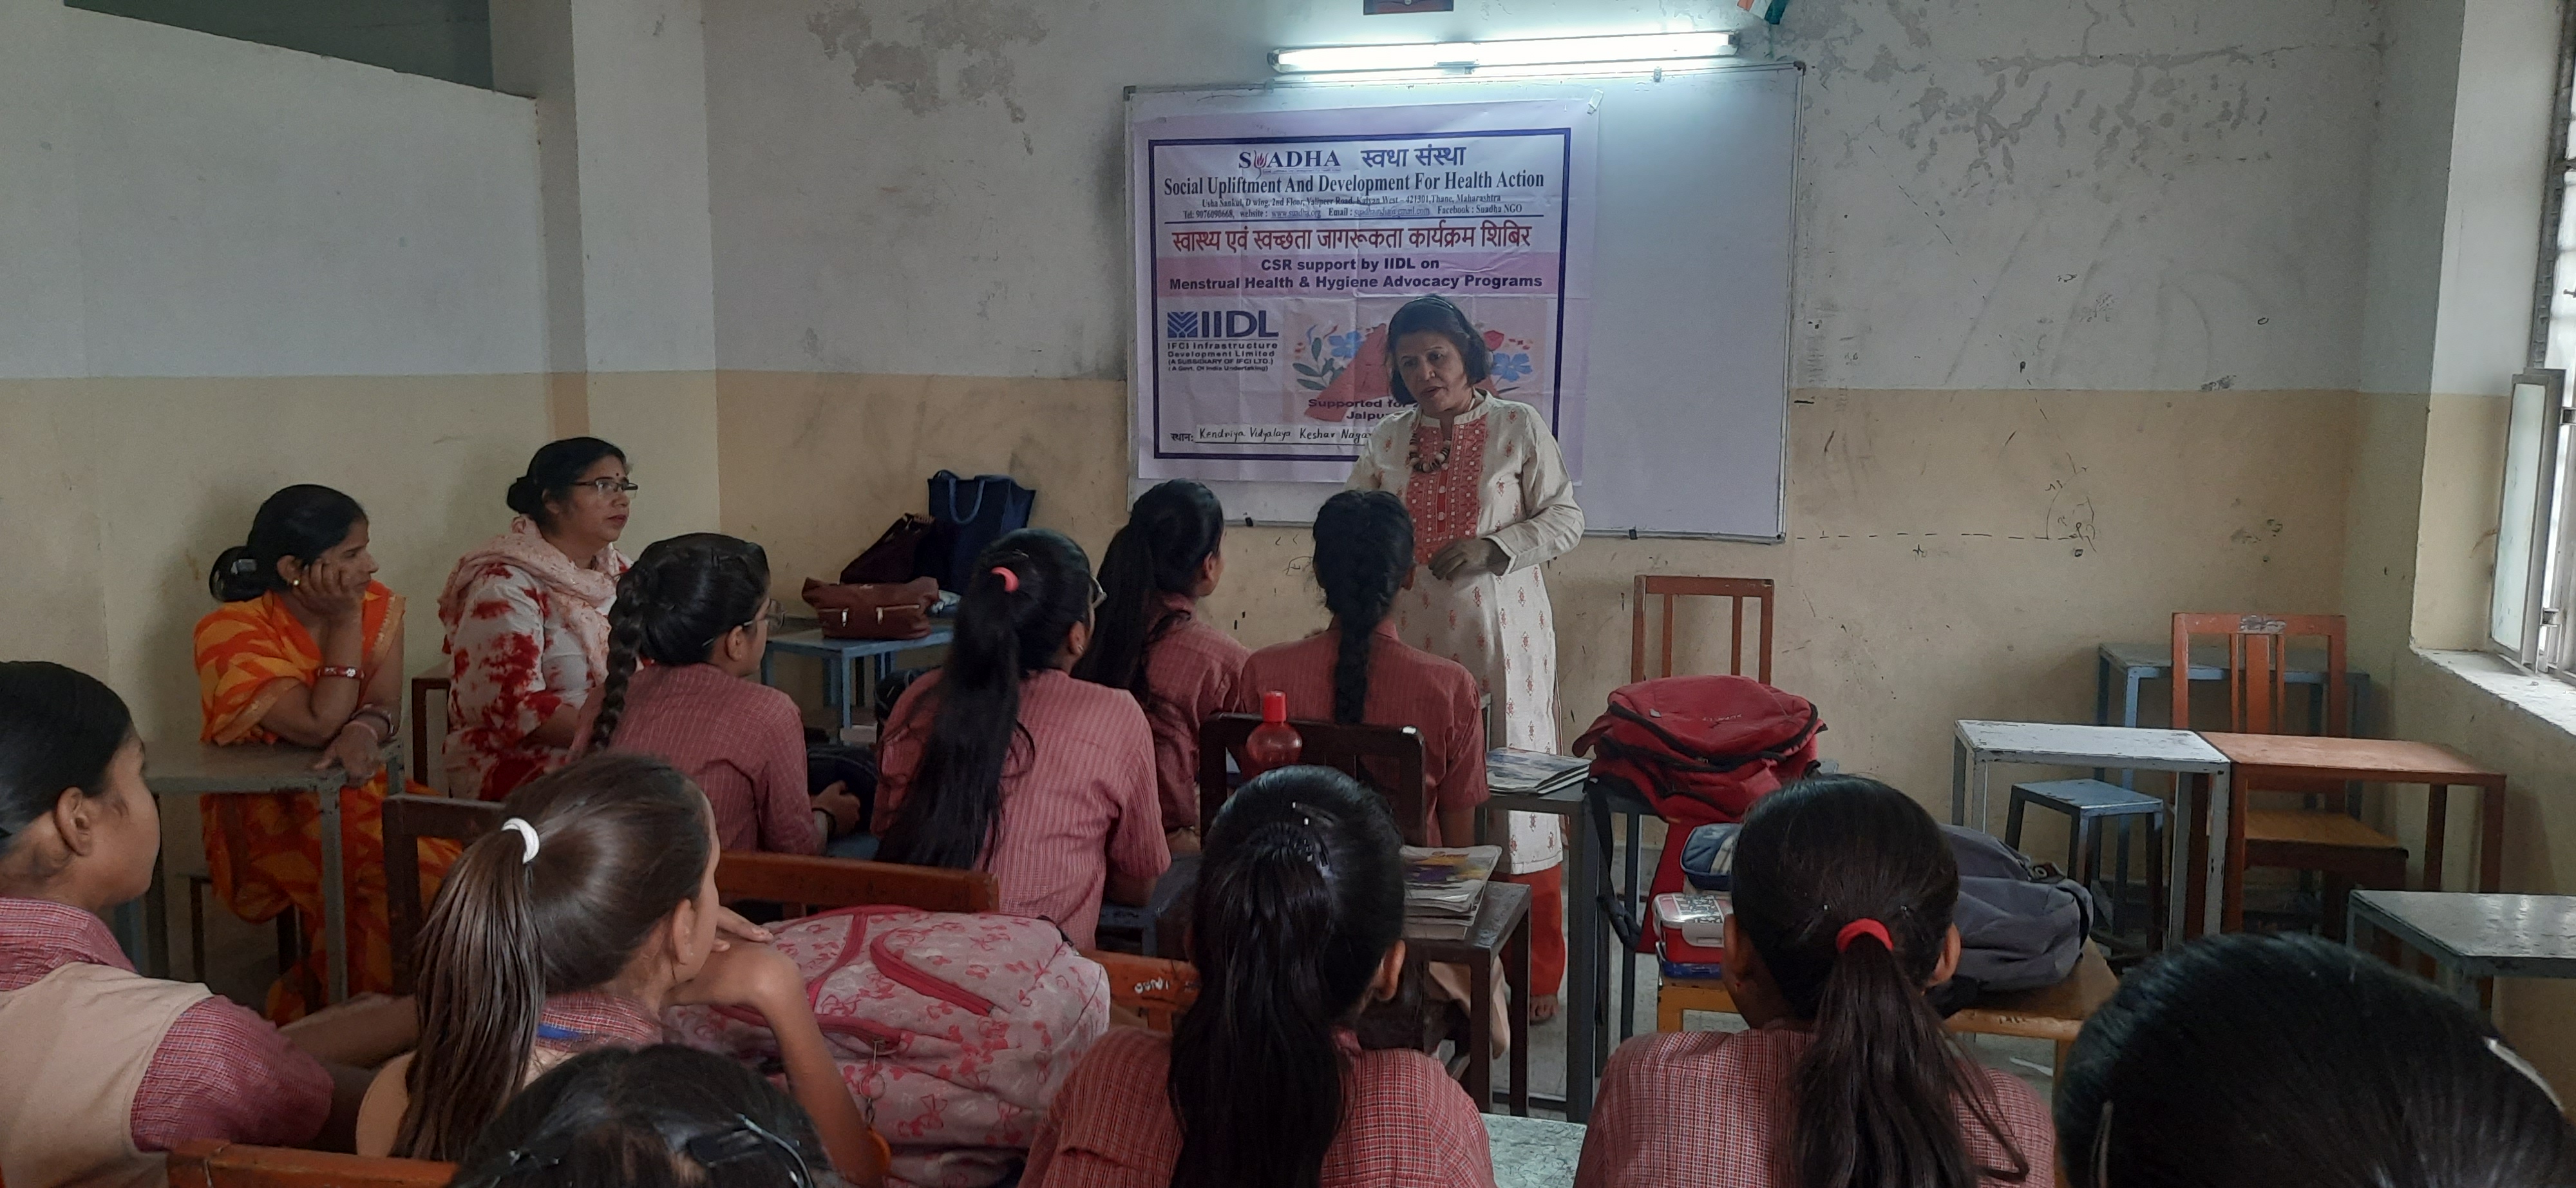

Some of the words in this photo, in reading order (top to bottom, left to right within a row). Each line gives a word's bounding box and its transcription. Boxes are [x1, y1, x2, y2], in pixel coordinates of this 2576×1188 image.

[1360, 149, 1409, 168] स्वधा
[1414, 144, 1466, 166] संस्था
[1164, 178, 1203, 195] Social
[1208, 176, 1282, 199] Upliftment
[1287, 174, 1313, 193] And
[1318, 173, 1410, 196] Development
[1416, 172, 1440, 189] For
[1444, 171, 1492, 189] Health
[1496, 169, 1544, 187] Action
[1202, 198, 1218, 207] Usha
[1245, 198, 1251, 206] D
[1272, 197, 1284, 206] 2nd
[1357, 195, 1380, 206] Kalyan
[1382, 195, 1398, 204] West
[1456, 193, 1501, 202] Maharashtra
[1240, 209, 1264, 218] website
[1329, 207, 1348, 216] Email
[1437, 205, 1470, 214] Facebook
[1475, 204, 1502, 213] Suadha
[1504, 204, 1522, 213] NGO
[1171, 231, 1222, 252] स्वास्थ्य
[1225, 225, 1249, 253] एवं
[1253, 229, 1313, 250] स्वच्छता
[1316, 228, 1404, 249] जागरूकता
[1408, 219, 1476, 248] कार्यक्रम
[1480, 219, 1532, 247] शिबिर
[1261, 259, 1292, 271] CSR
[1297, 258, 1356, 273] support
[1361, 258, 1379, 272] by
[1384, 258, 1416, 269] IIDL
[1421, 260, 1439, 269] on
[1170, 278, 1240, 290] Menstrual
[1244, 276, 1293, 289] Health
[1298, 276, 1310, 288] &
[1316, 276, 1378, 291] Hygiene
[1383, 276, 1459, 289] Advocacy
[1464, 274, 1542, 289] Programs
[1202, 310, 1279, 338] IIDL
[1308, 399, 1382, 408] Supported
[1347, 411, 1391, 421] Jaipu
[1199, 428, 1245, 443] Kendriya
[1250, 426, 1291, 441] Vidyalaya
[1300, 428, 1336, 439] Keshar
